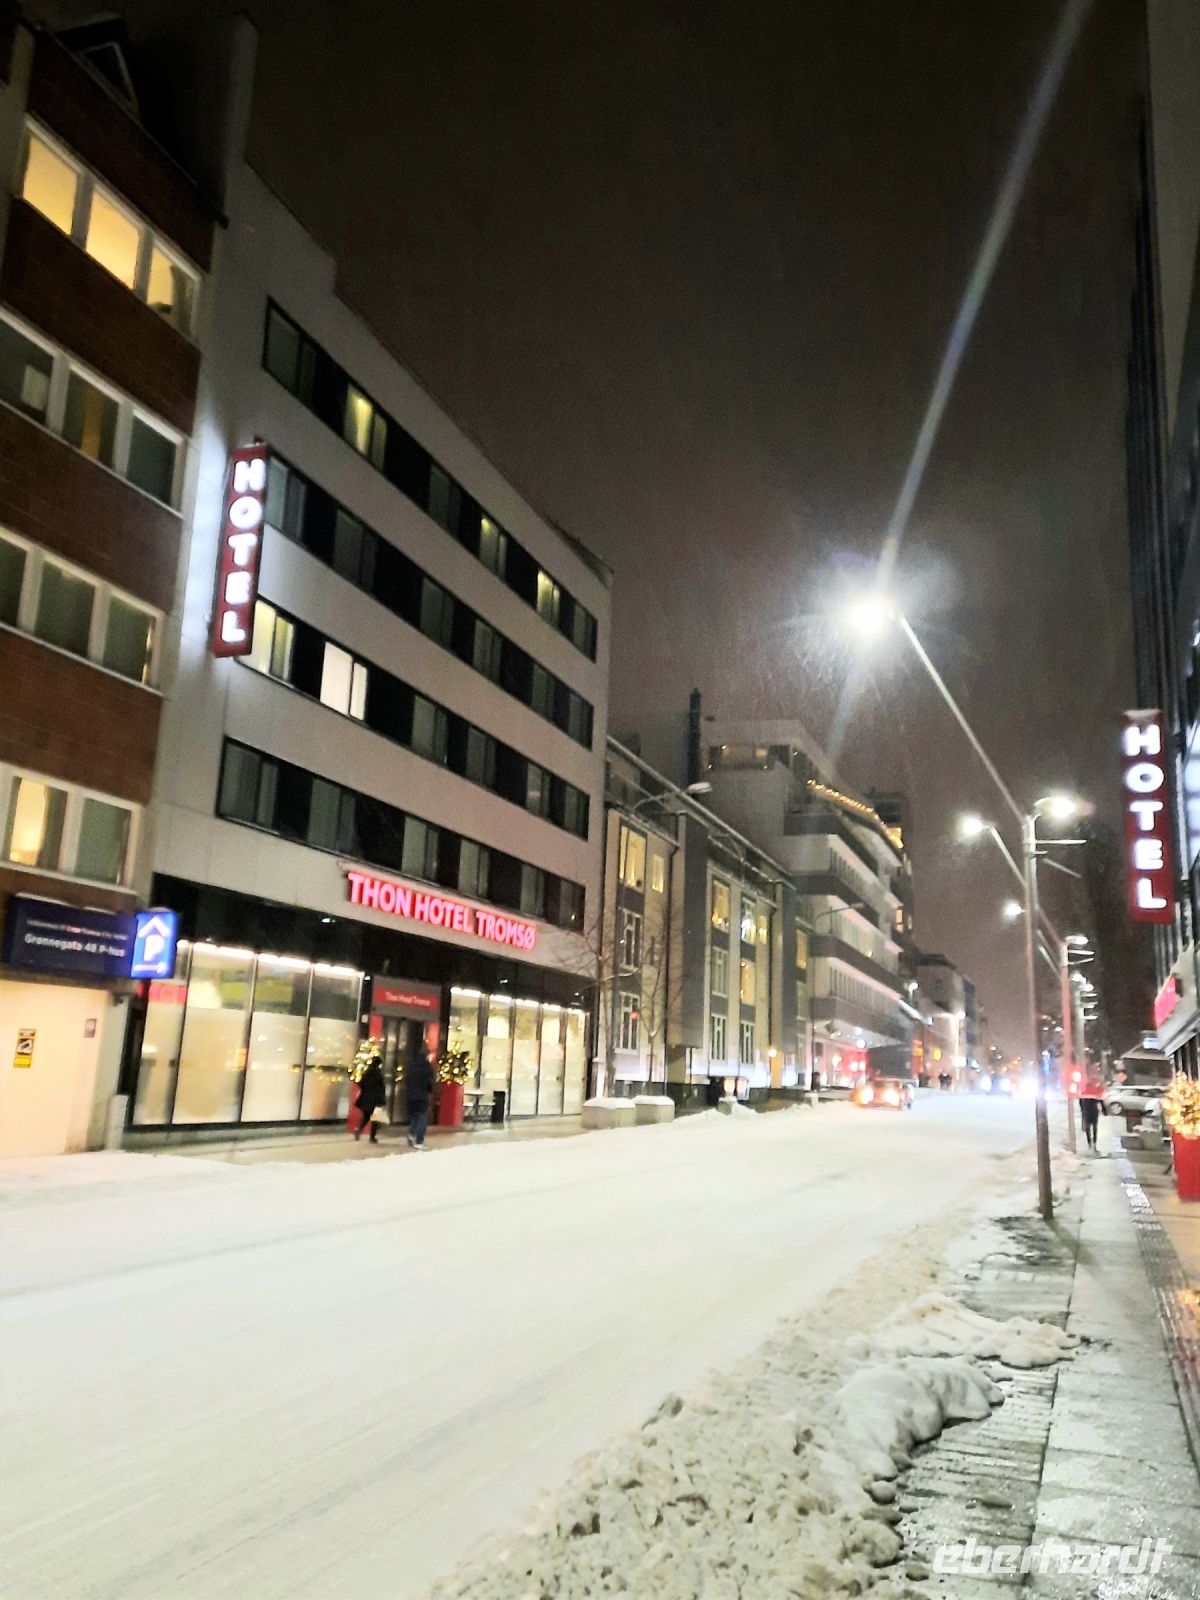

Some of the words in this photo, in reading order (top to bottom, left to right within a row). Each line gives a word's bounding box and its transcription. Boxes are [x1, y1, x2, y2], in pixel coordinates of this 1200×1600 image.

[220, 457, 267, 643] HOTEL
[1123, 723, 1168, 910] HOTEL
[347, 871, 413, 918] THON
[413, 892, 474, 935] HOTEL
[475, 910, 536, 950] TROMSØ
